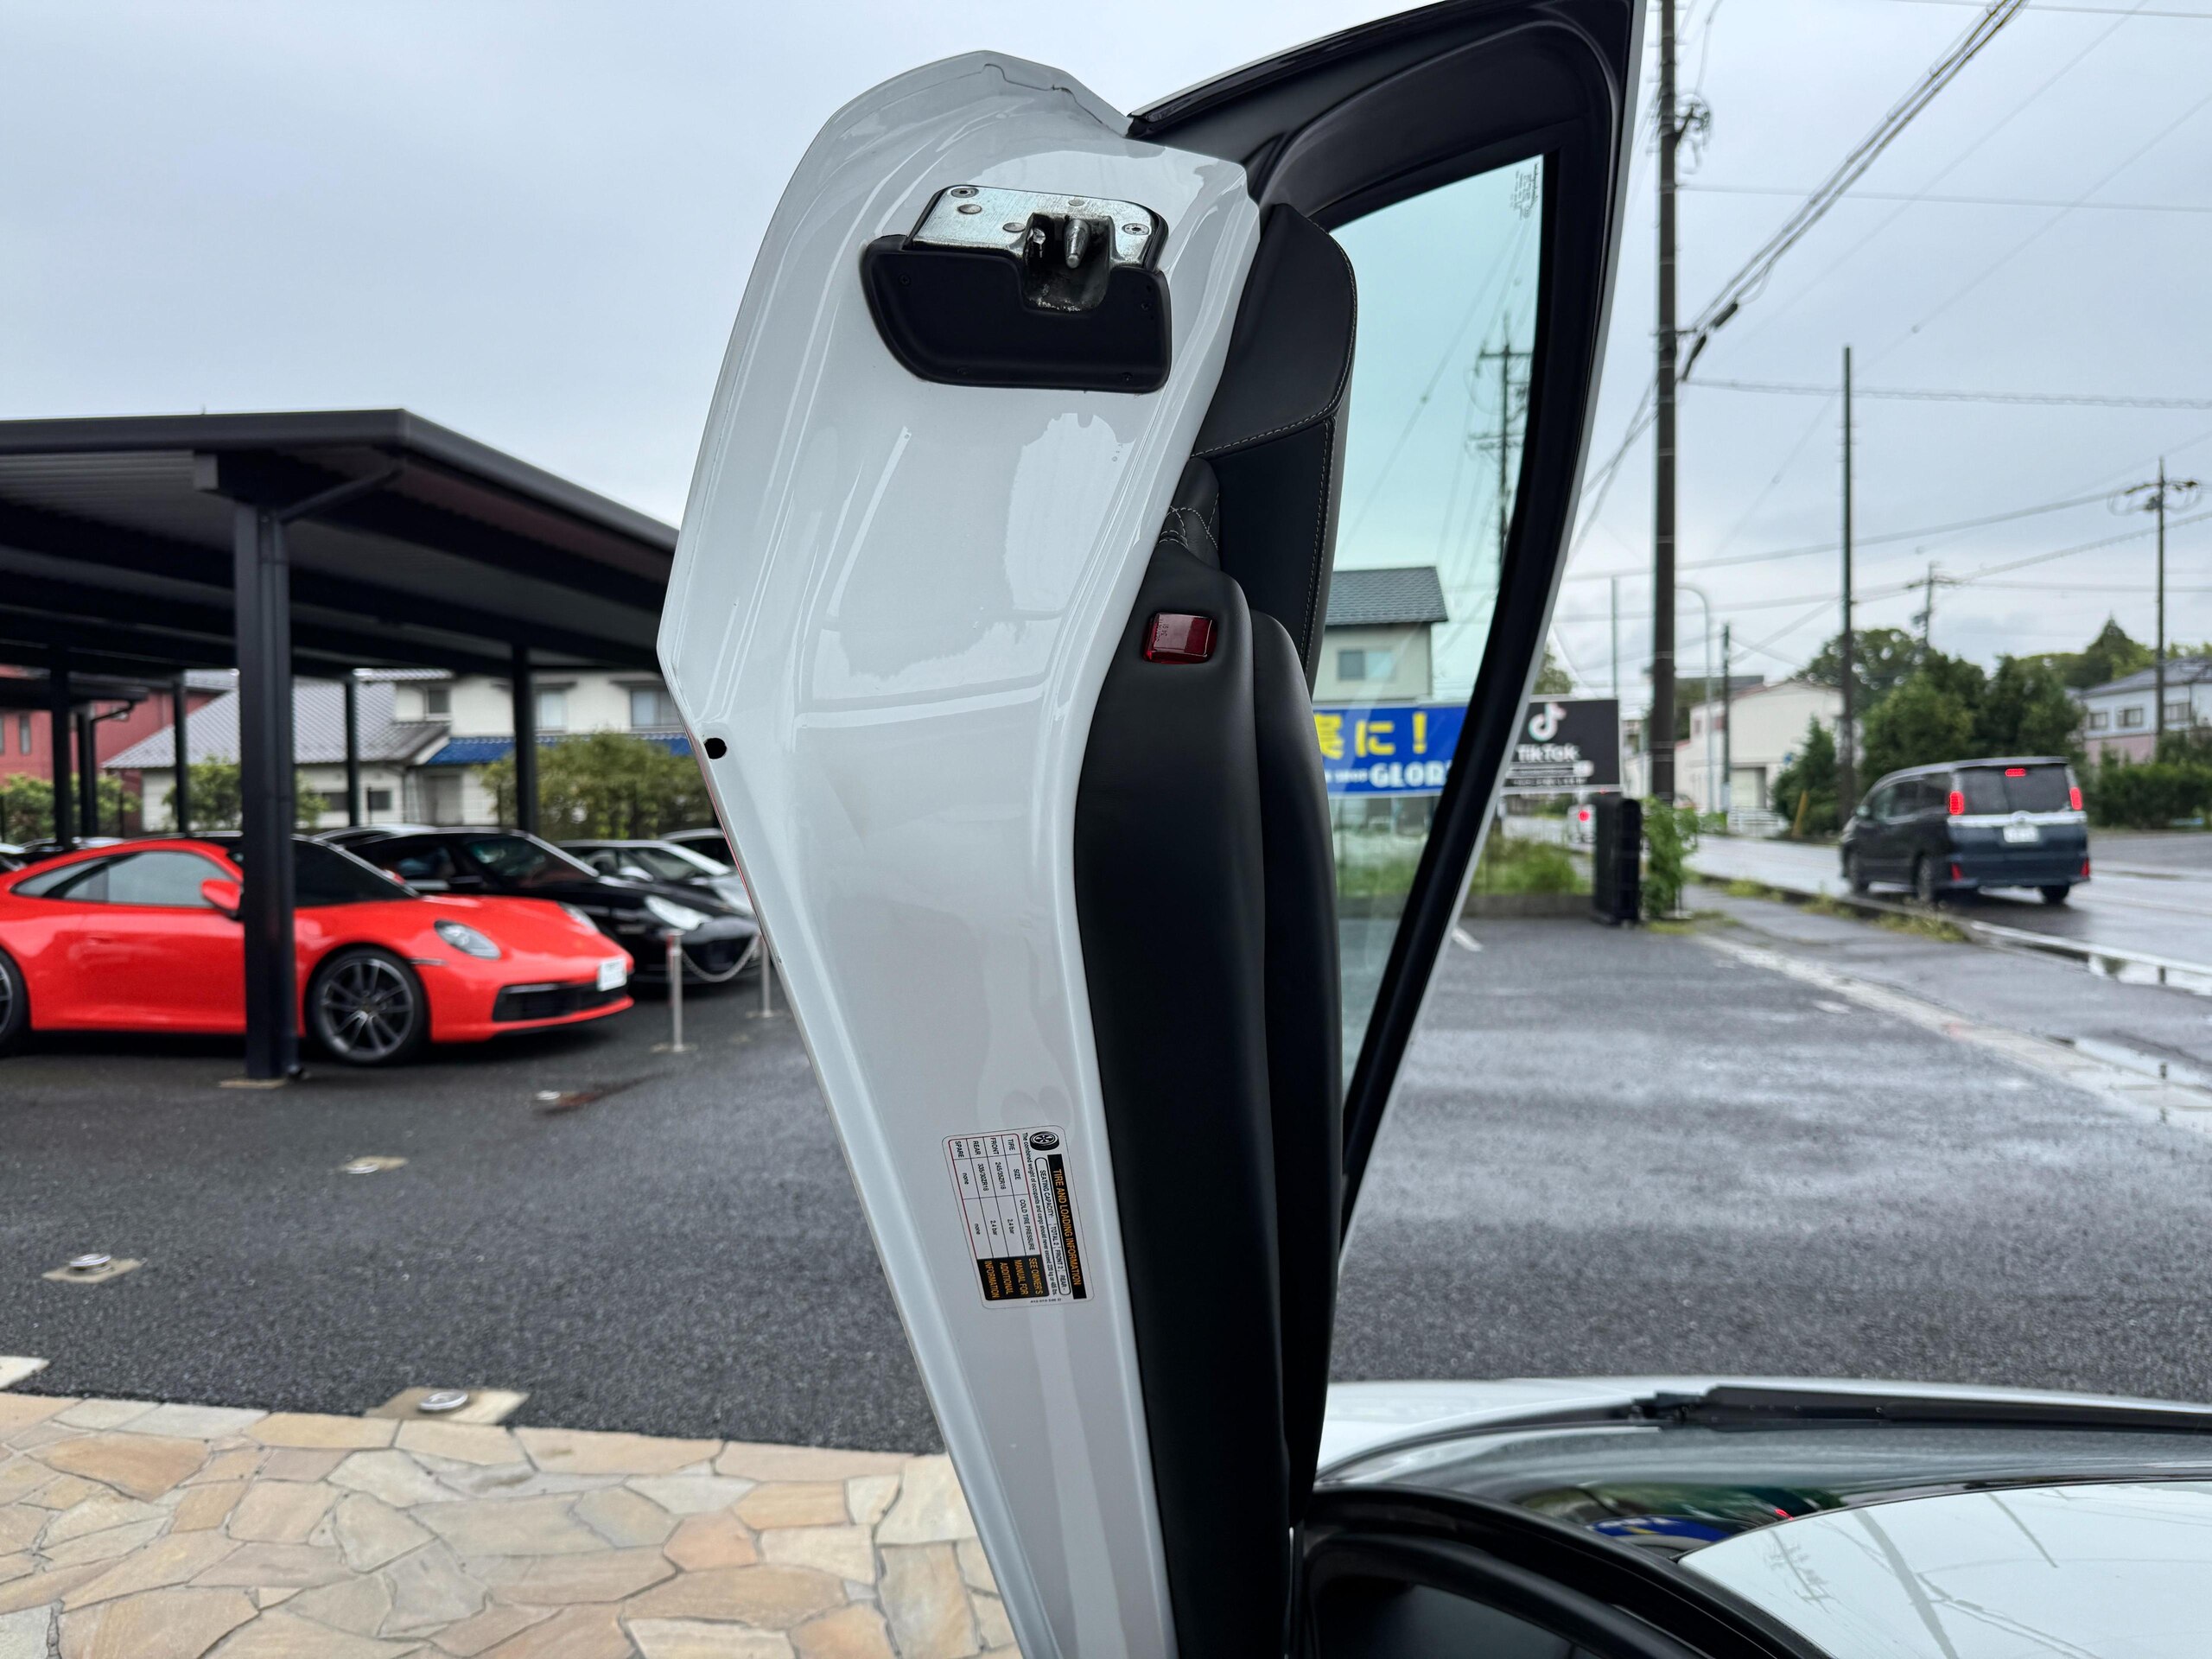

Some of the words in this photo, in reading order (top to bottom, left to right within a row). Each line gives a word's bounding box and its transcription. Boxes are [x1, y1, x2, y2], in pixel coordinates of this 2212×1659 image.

[1517, 743, 1580, 762] TikTok
[954, 1141, 964, 1157] SPARE
[972, 1141, 981, 1154] REAR
[989, 1137, 999, 1154] FRONT
[1007, 1138, 1015, 1150] TIRE
[1023, 1141, 1033, 1162] combined
[976, 1163, 988, 1191] 335/30ZR18
[994, 1161, 1006, 1189] 245/35ZR18
[1026, 1163, 1035, 1177] weight
[1052, 1168, 1064, 1186] TIRE
[1039, 1169, 1049, 1191] SEATING
[1030, 1183, 1040, 1204] occupants
[1056, 1186, 1067, 1203] AND
[1019, 1198, 1027, 1212] COLD
[1043, 1192, 1054, 1217] CAPACITY:
[1021, 1213, 1030, 1224] TIRE
[1035, 1212, 1044, 1224] cargo
[1058, 1205, 1073, 1236] LOADING
[1024, 1225, 1035, 1250] PRESSURE
[1050, 1226, 1058, 1241] TOTAL
[1028, 1257, 1038, 1268] SEE
[1054, 1249, 1063, 1264] FRONT
[1065, 1237, 1082, 1285] INFORMATION
[983, 1260, 1000, 1298] INFORMATION
[999, 1262, 1014, 1294] ADDITIONAL
[1013, 1259, 1026, 1283] MANUAL
[1018, 1283, 1028, 1294] FOR
[1030, 1268, 1043, 1294] OWNER'S
